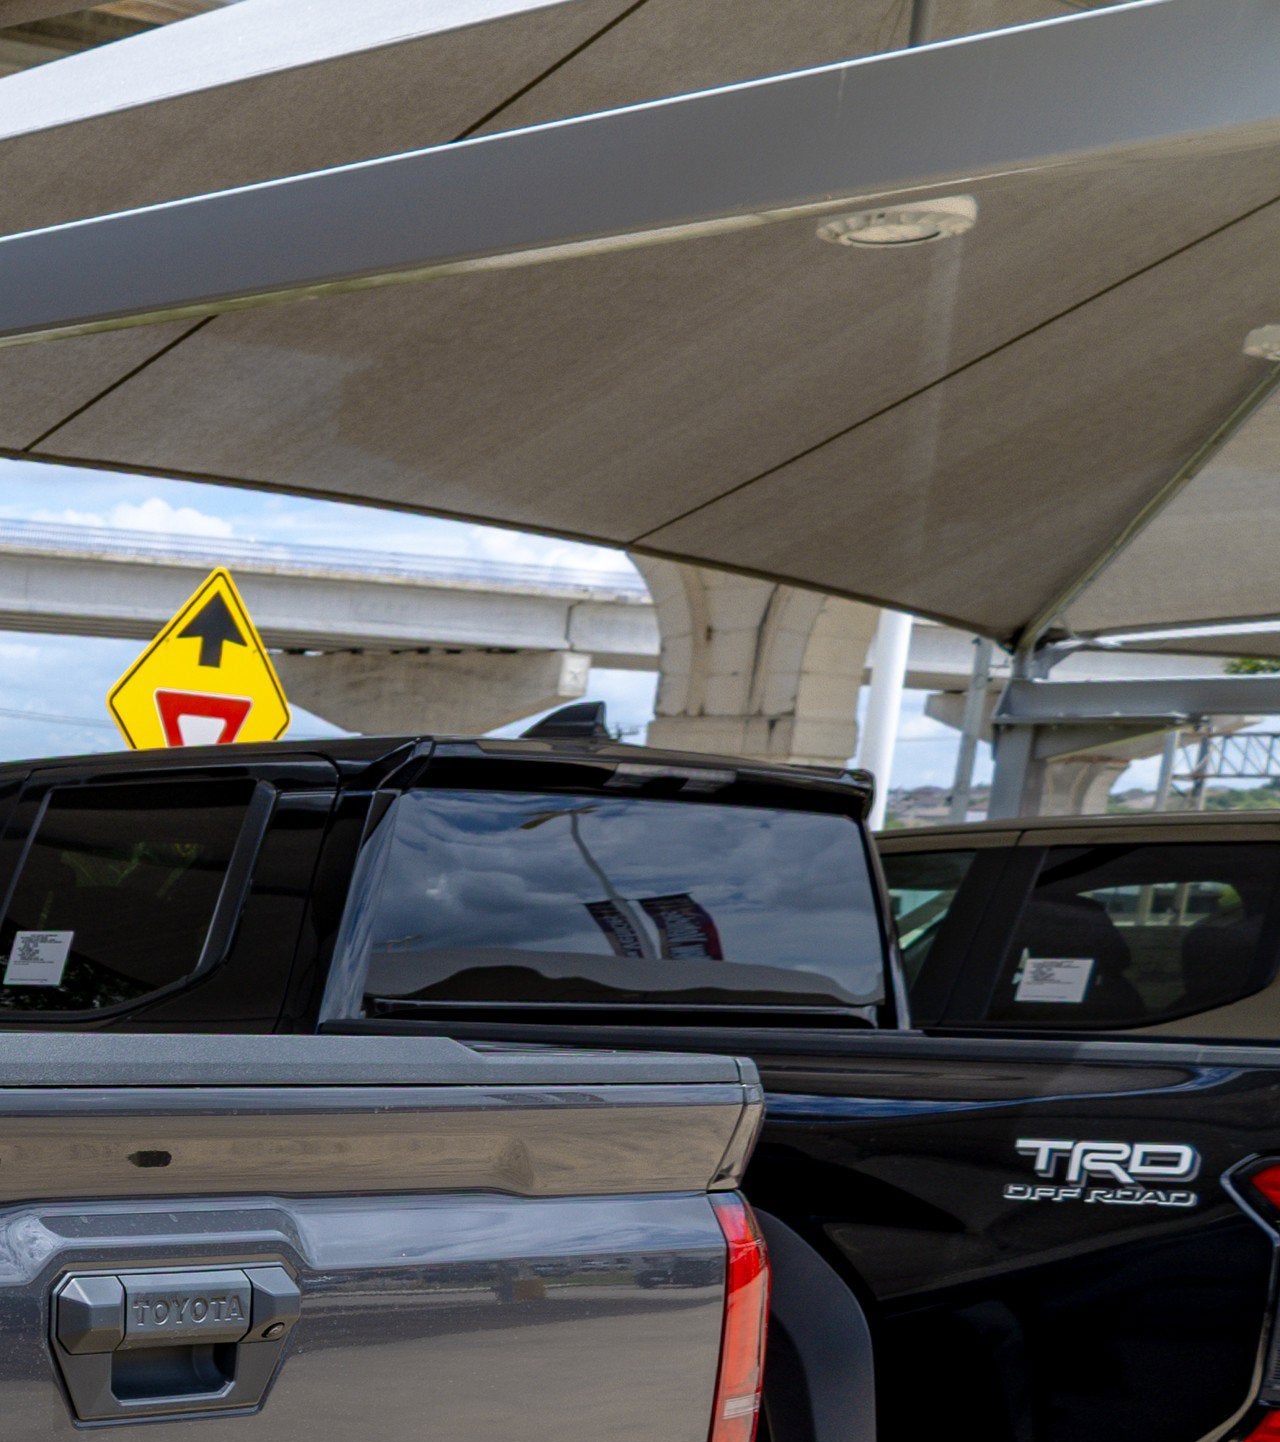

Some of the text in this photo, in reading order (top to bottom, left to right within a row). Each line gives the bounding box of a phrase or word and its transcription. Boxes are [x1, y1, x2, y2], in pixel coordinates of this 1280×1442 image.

[1015, 1138, 1200, 1187] TRD
[1003, 1183, 1197, 1207] OFF ROAD
[132, 1294, 244, 1326] TOYOTA
